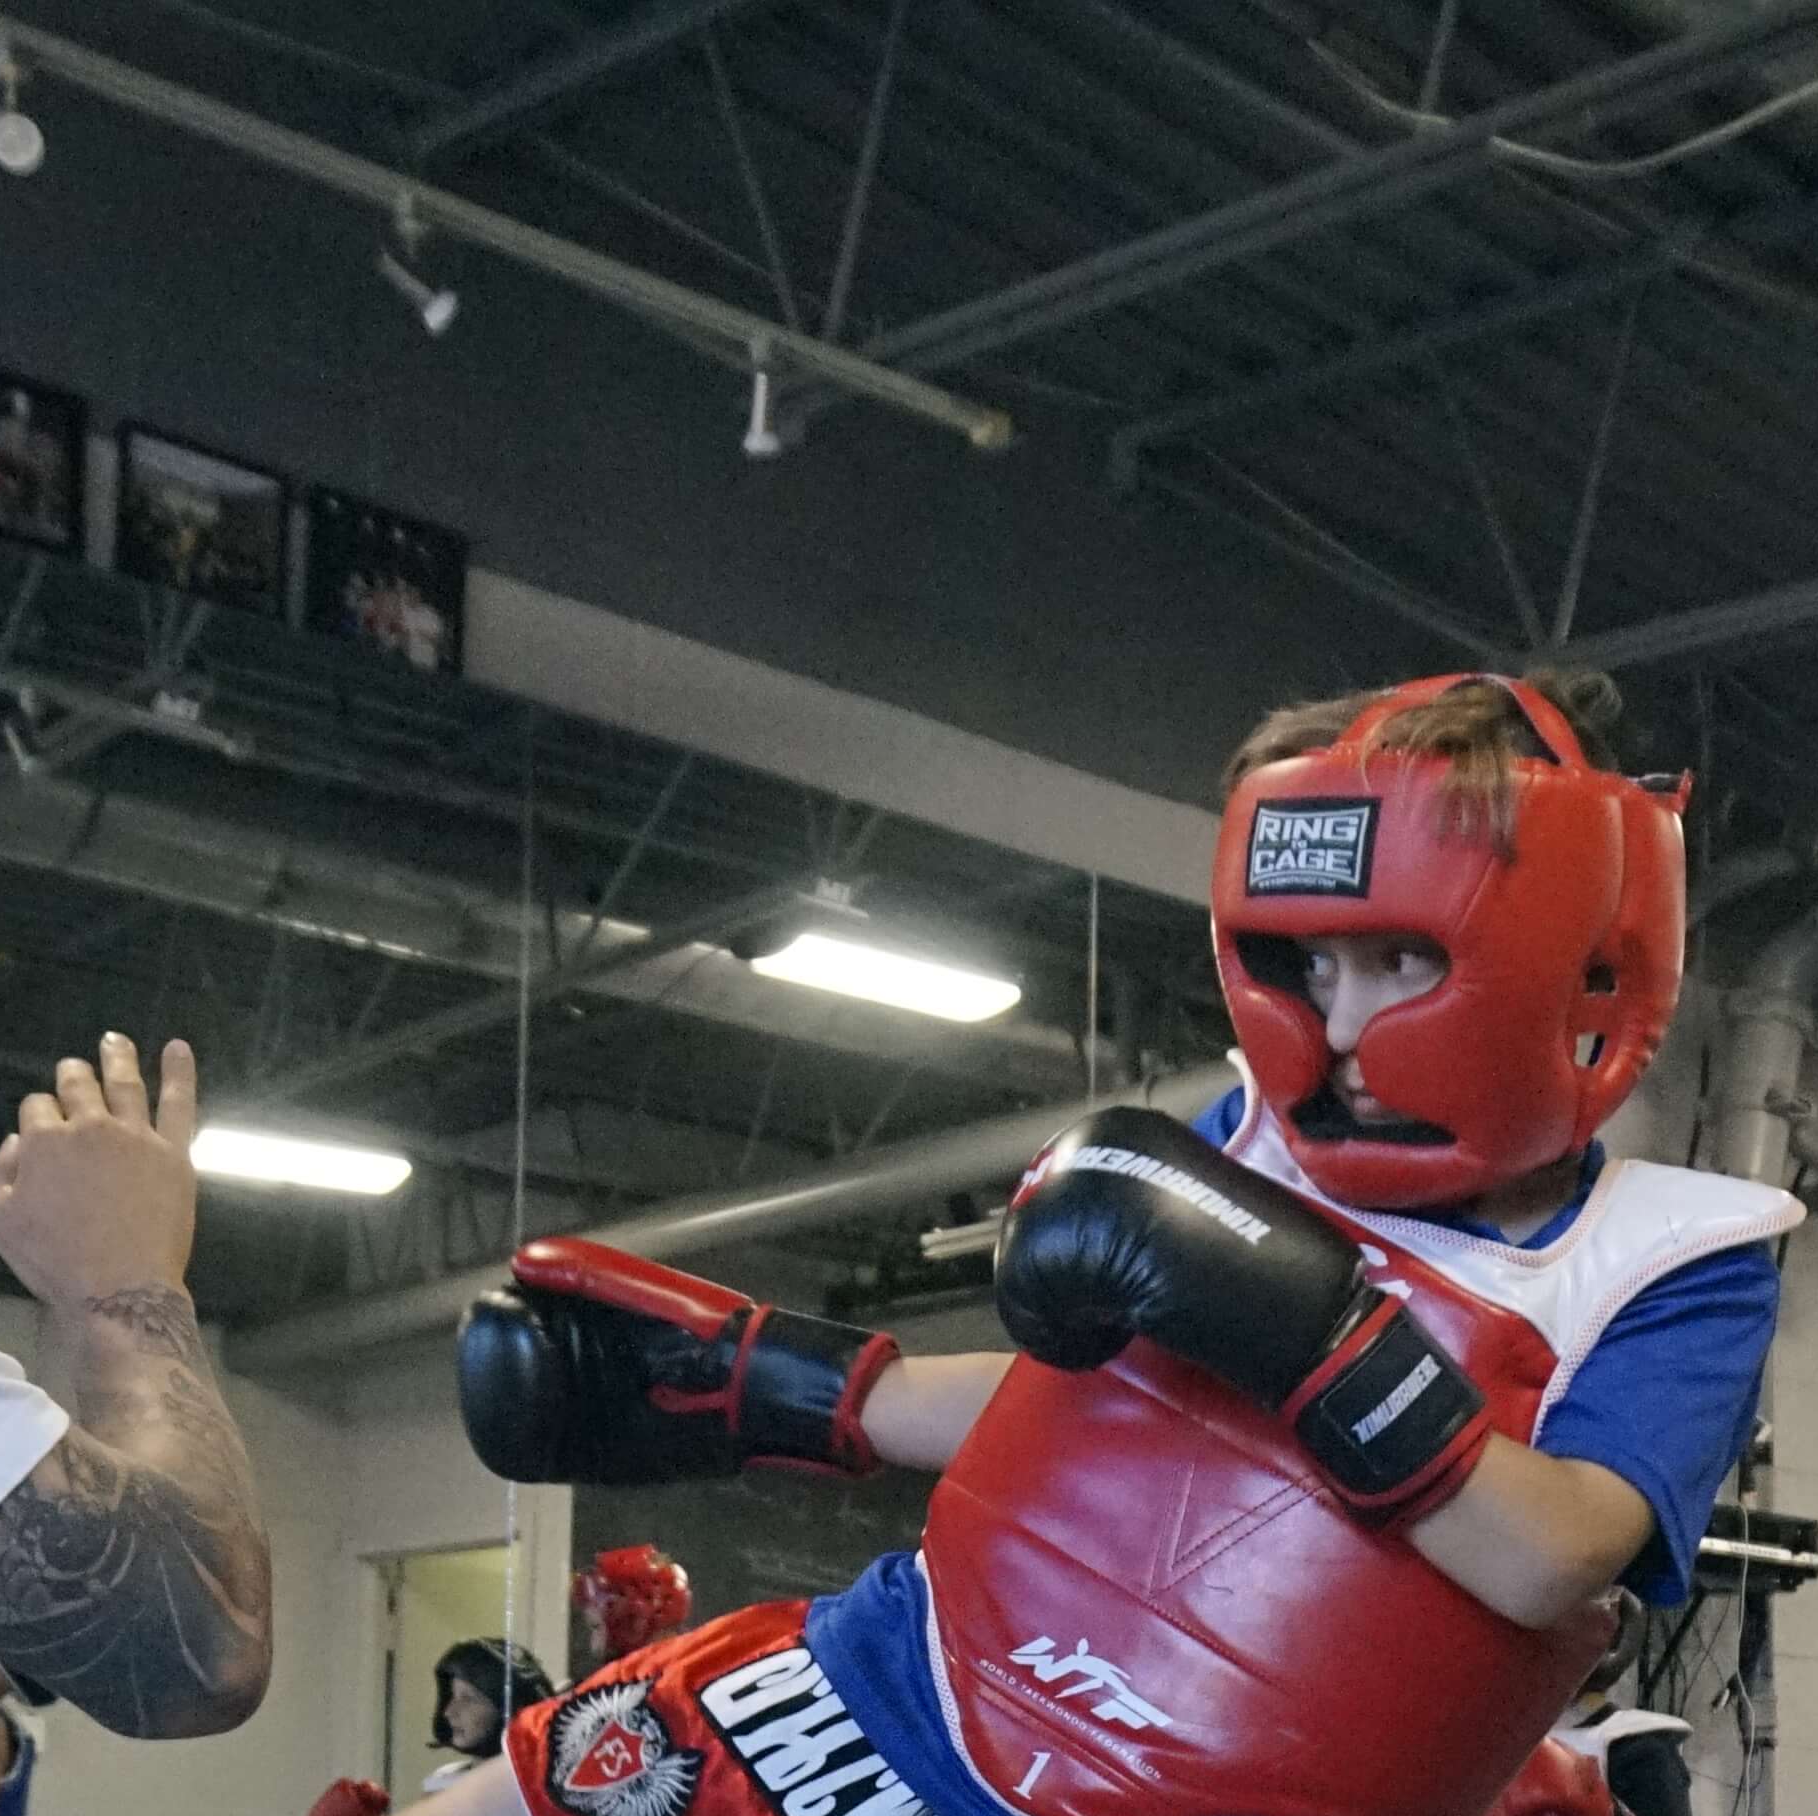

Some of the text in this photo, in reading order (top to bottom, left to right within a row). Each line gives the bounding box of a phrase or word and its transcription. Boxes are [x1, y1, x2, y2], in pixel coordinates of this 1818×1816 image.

[1258, 814, 1360, 843] RING
[1254, 848, 1354, 876] CAGE
[1007, 1635, 1174, 1730] WTF
[979, 1658, 1163, 1782] WORLD TAEKWONDO FEDERATION
[593, 1736, 633, 1778] FS
[1012, 1751, 1052, 1801] 1
